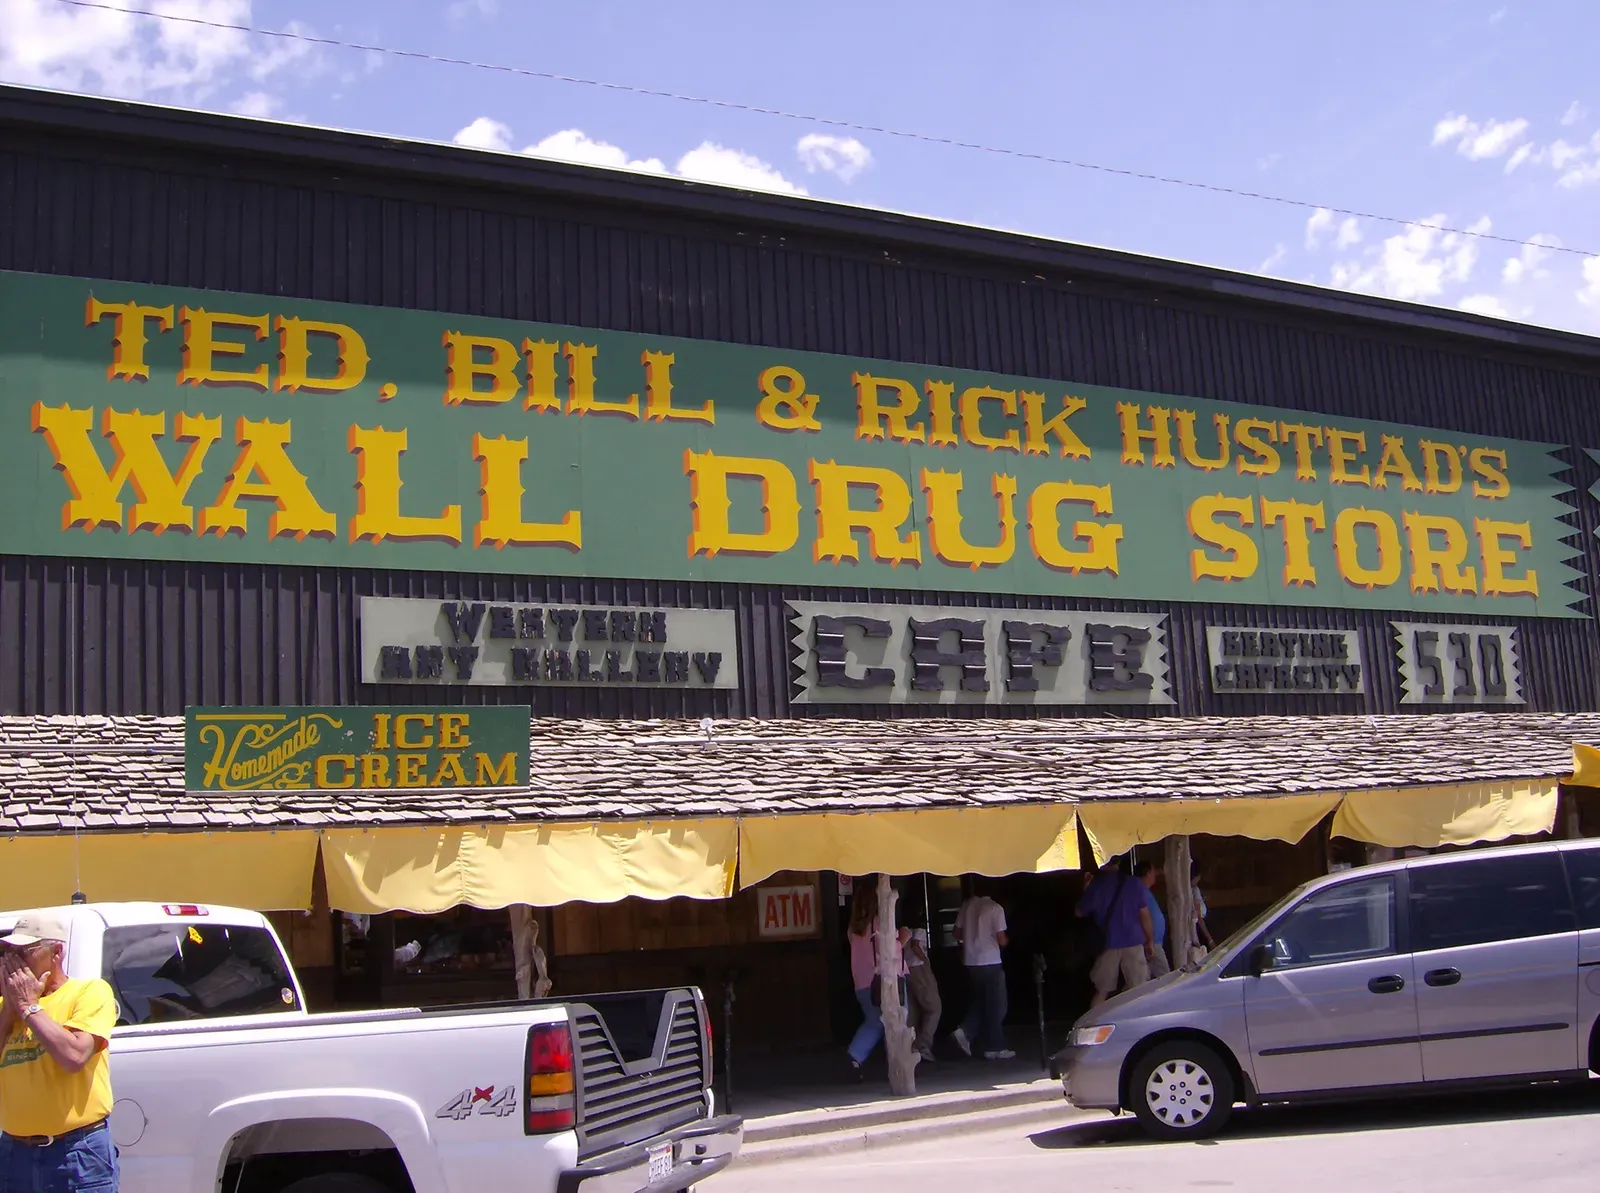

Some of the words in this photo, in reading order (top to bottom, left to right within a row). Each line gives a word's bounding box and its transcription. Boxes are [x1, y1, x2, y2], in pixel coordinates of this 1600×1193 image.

[443, 329, 715, 425] BILL
[756, 364, 821, 433] &
[853, 370, 1092, 462] RICK
[1117, 400, 1511, 500] HUSTEAD'S
[31, 401, 583, 552] WALL
[684, 447, 1124, 577] DRUG
[1189, 491, 1538, 600] STORE
[442, 602, 667, 643] WESTERN
[381, 645, 479, 680] ART
[511, 649, 722, 684] GALLERY
[813, 614, 1154, 692] CAFE
[1222, 631, 1348, 659] SEATING
[1414, 630, 1507, 697] 530
[1214, 664, 1361, 690] CAPACITY
[373, 713, 471, 750] ICE
[200, 716, 321, 790] Homemade
[314, 752, 518, 789] CREAM
[765, 892, 812, 928] ATM
